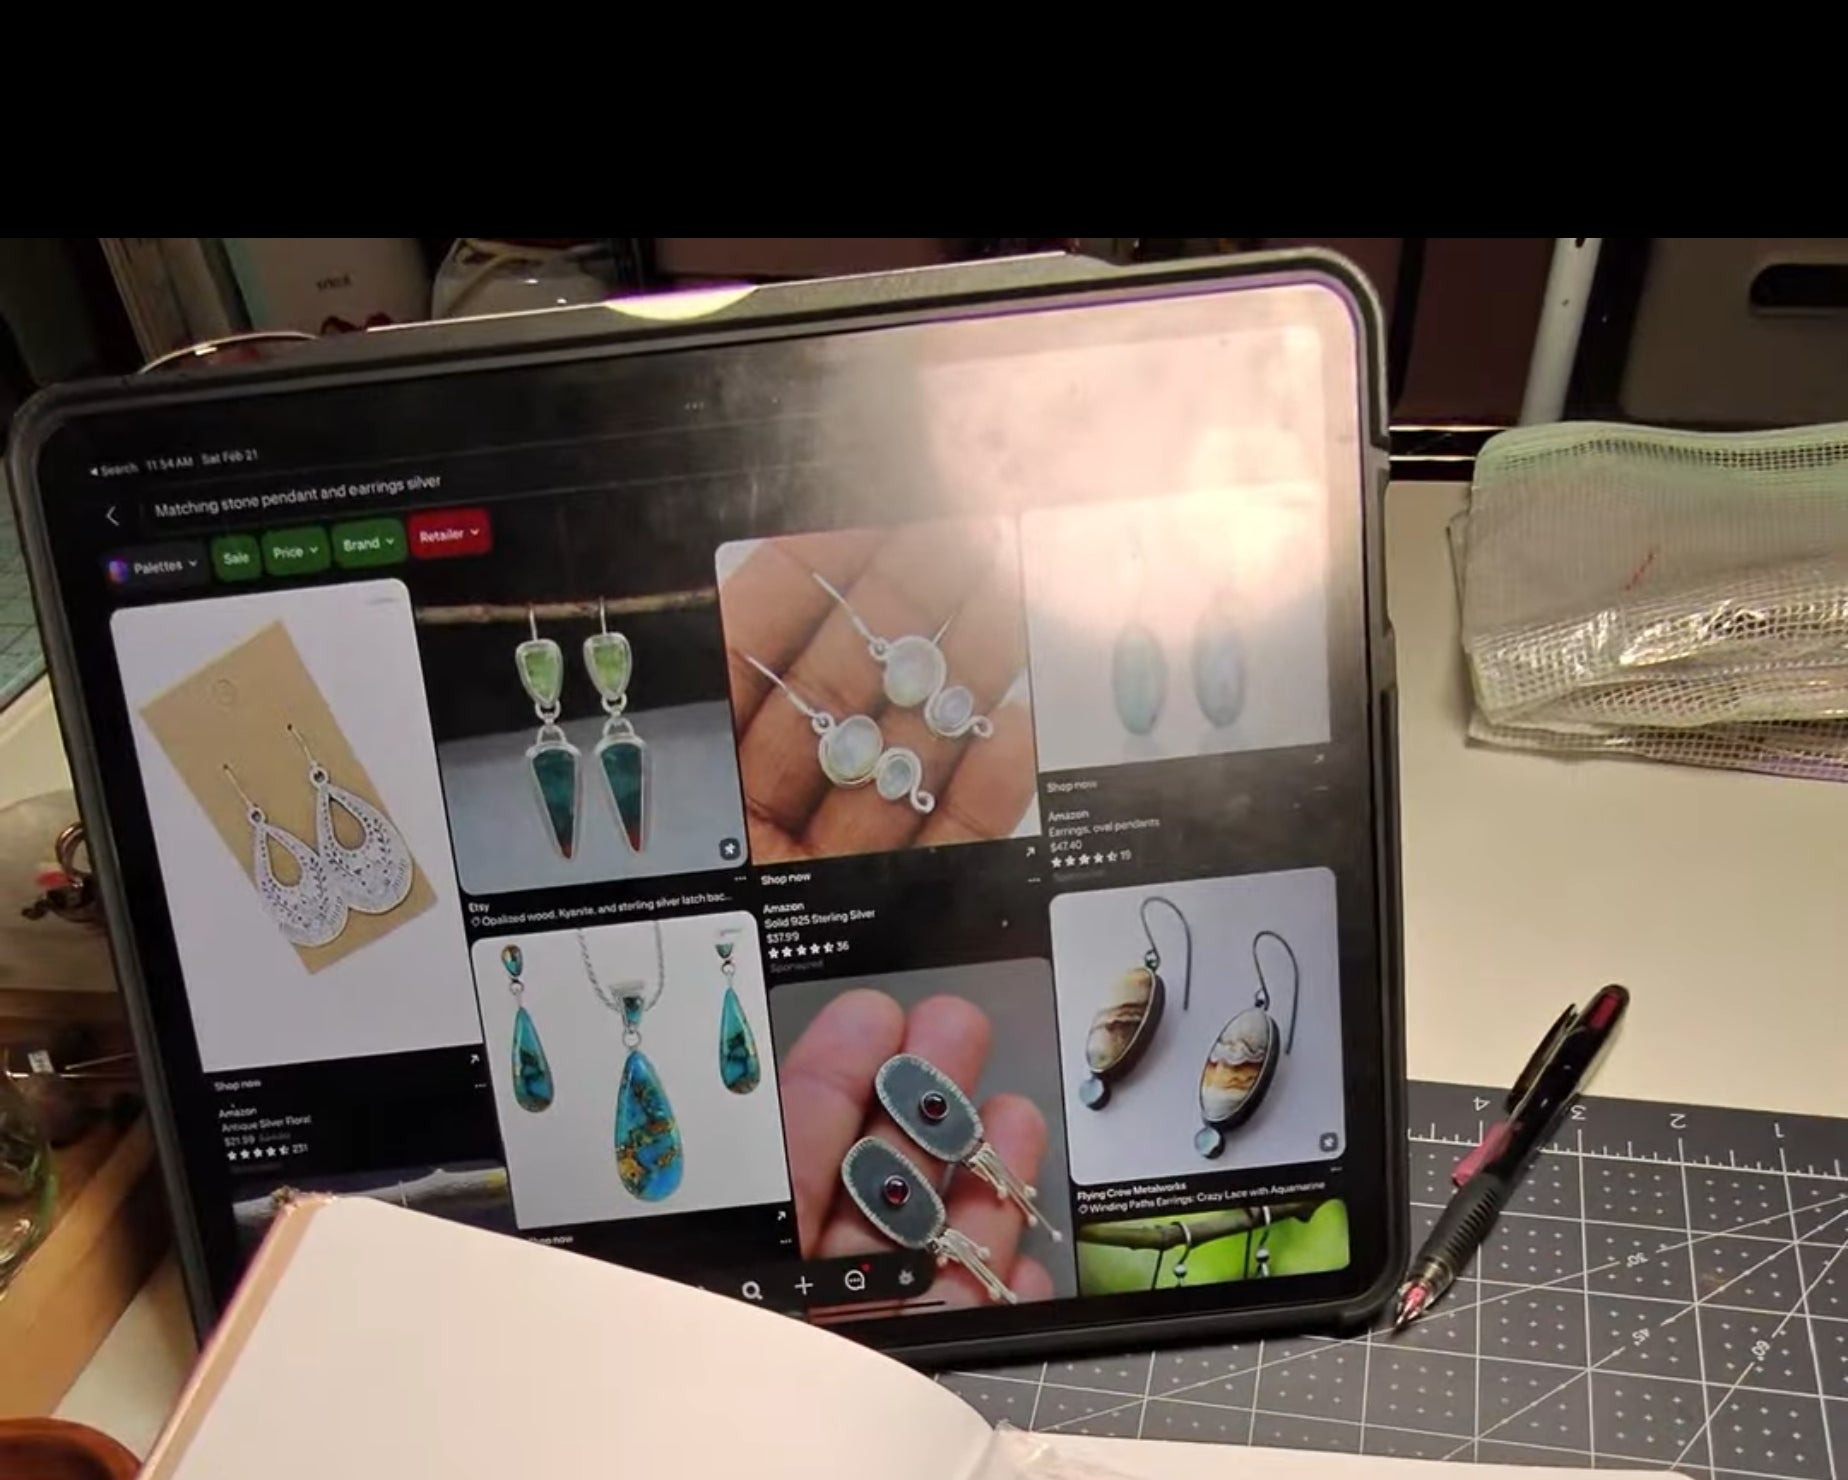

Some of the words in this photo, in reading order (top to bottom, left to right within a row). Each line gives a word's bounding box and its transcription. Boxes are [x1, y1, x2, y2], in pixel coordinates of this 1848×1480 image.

[101, 463, 139, 477] Search
[201, 452, 221, 465] Sat
[222, 450, 243, 463] Feb
[155, 500, 220, 518] Matching
[221, 497, 260, 510] stone
[261, 488, 317, 508] pendant
[320, 484, 347, 498] and
[349, 478, 405, 496] earrings
[407, 475, 442, 489] silver
[419, 528, 465, 544] Retailer
[273, 545, 304, 559] Price
[342, 538, 381, 553] Brand
[223, 551, 250, 566] Sale
[133, 560, 183, 575] Palettes
[1048, 810, 1090, 822] Amazon
[760, 874, 787, 886] Shop
[788, 872, 812, 882] now
[467, 902, 490, 914] Etsy
[482, 911, 527, 927] Opalized
[598, 902, 617, 914] and
[618, 899, 655, 911] sterling
[656, 896, 680, 908] silver
[681, 893, 706, 905] latch
[763, 902, 806, 914] Amazon
[764, 917, 790, 929] Solid
[790, 914, 810, 927] 925
[811, 911, 849, 924] Sterling
[849, 909, 876, 921] Silver
[213, 1080, 240, 1093] Shop
[240, 1079, 263, 1090] now
[1472, 1096, 1491, 1112] 4
[219, 1107, 258, 1119] Amazon
[1569, 1104, 1588, 1121] 3
[258, 1117, 284, 1129] Silver
[1669, 1112, 1688, 1130] 2
[1772, 1122, 1786, 1139] 1
[1076, 1189, 1106, 1203] Flying
[1132, 1181, 1188, 1196] Metalworks
[1089, 1201, 1129, 1214] Winding
[1196, 1191, 1223, 1203] Crazy
[1223, 1189, 1249, 1200] Lace
[1248, 1186, 1270, 1198] with
[1270, 1180, 1326, 1195] Aquamarine
